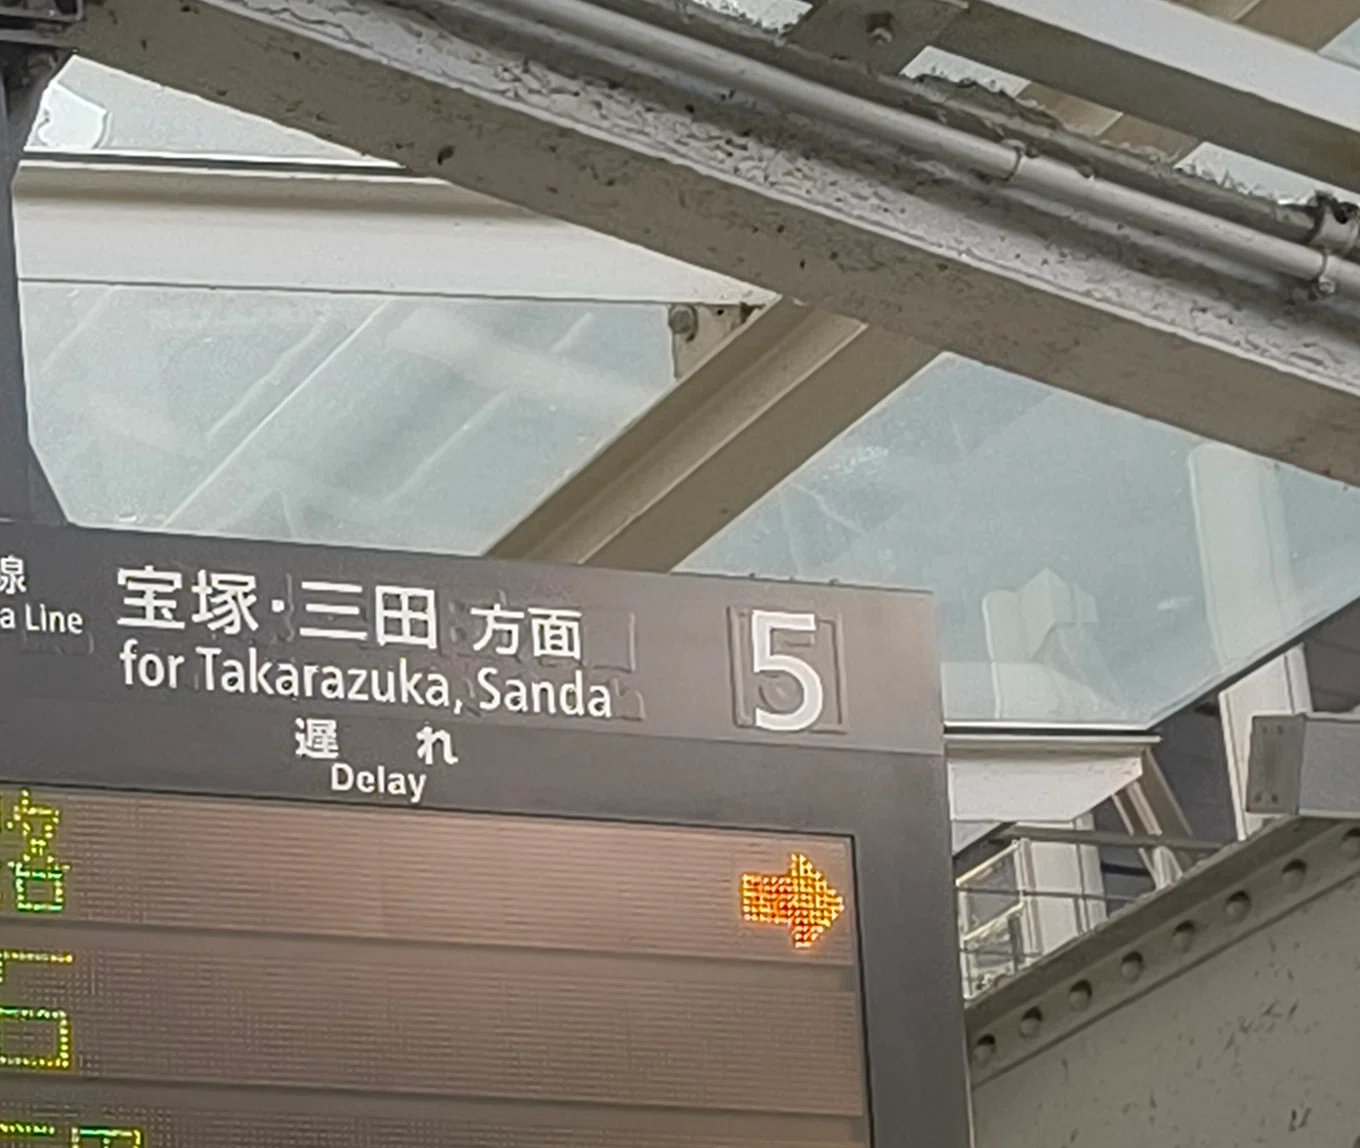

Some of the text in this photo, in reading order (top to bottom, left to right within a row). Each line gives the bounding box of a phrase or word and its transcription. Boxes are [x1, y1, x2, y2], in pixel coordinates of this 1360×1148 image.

[24, 602, 83, 635] Line
[119, 639, 613, 718] for Takarazuka, Sanda
[751, 610, 824, 732] 5
[331, 761, 427, 803] Delay
